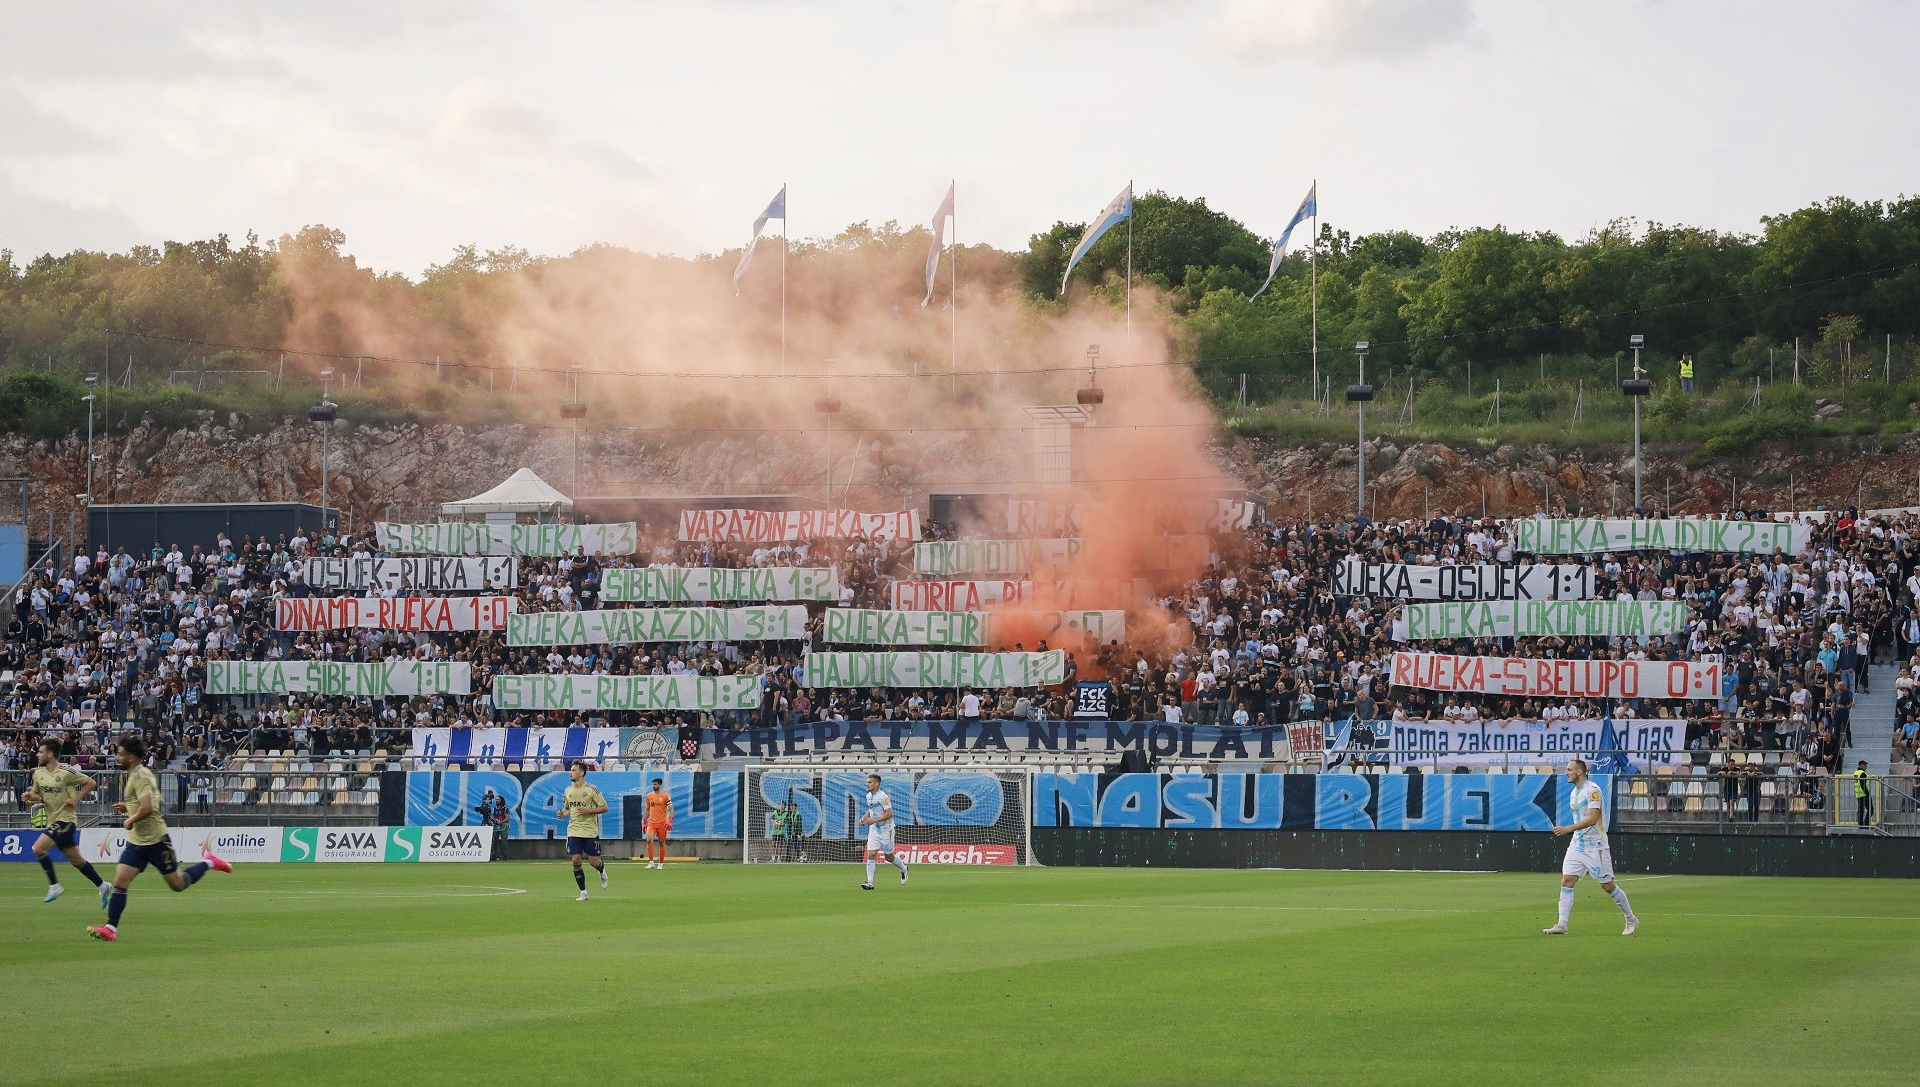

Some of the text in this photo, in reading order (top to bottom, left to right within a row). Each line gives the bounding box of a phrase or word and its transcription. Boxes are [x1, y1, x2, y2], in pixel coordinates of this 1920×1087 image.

[595, 522, 636, 556] 1:3
[869, 511, 914, 541] 2:0
[1737, 522, 1792, 555] 2:0
[479, 557, 514, 590] 1:1
[788, 568, 832, 600] 1:2
[1546, 566, 1588, 600] 1:1
[469, 598, 507, 631] 1:0
[745, 607, 789, 637] 3:1
[1648, 601, 1686, 634] 2:0
[410, 665, 450, 693] 1:0
[1018, 650, 1064, 686] 1:2
[1668, 661, 1720, 697] 0:1
[697, 675, 757, 709] 0:2
[1080, 687, 1107, 701] FCK
[713, 720, 1279, 758] KREPAT MA NE MOLAT
[1395, 726, 1449, 764] nema
[1537, 726, 1596, 760] jačeg
[1639, 726, 1674, 764] nas
[1031, 773, 1284, 829] NAŠU
[218, 833, 266, 847] uniline
[325, 833, 377, 849] SAVA
[429, 832, 482, 849] SAVA
[898, 845, 983, 865] aircash
